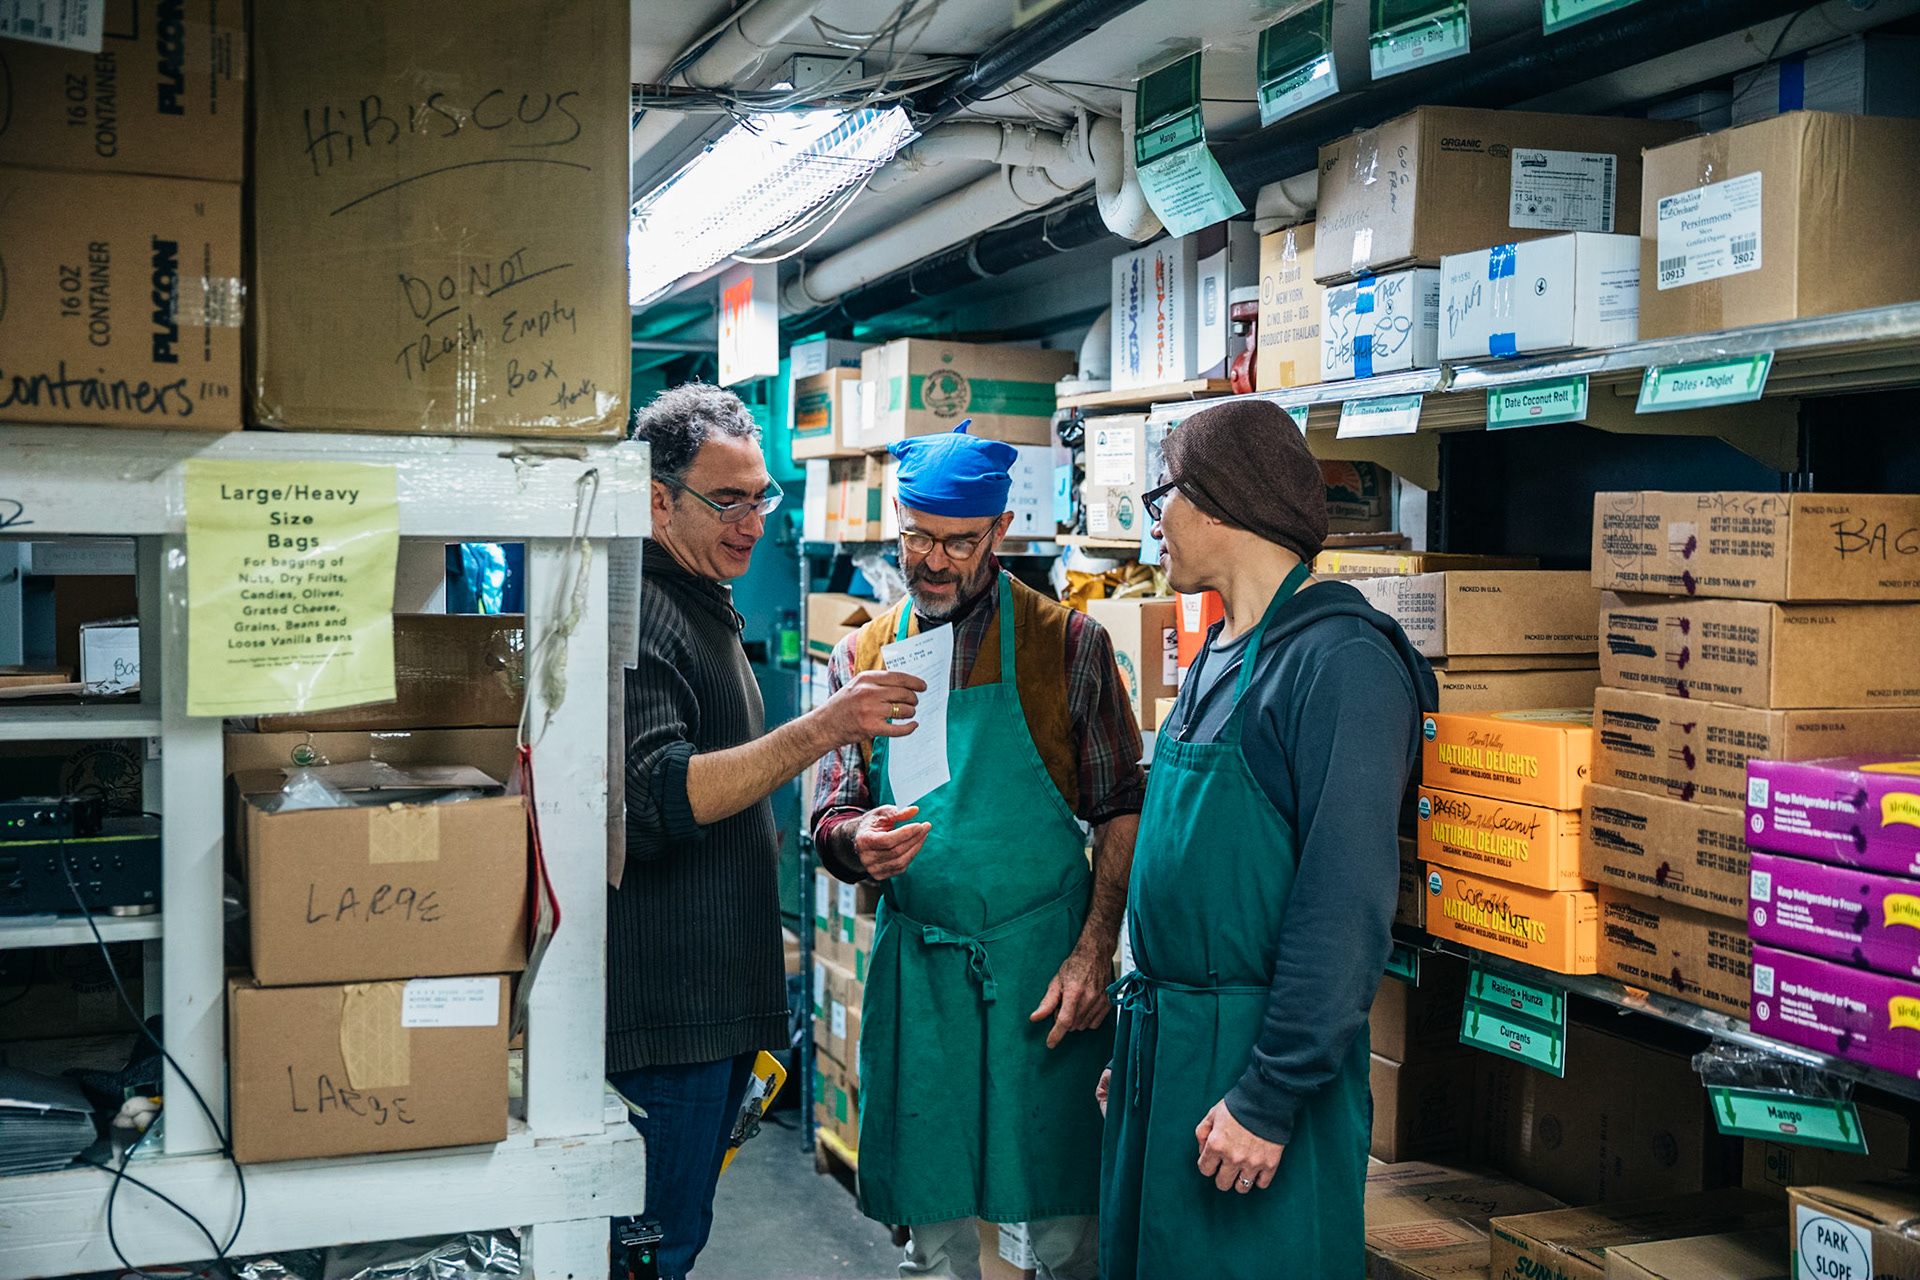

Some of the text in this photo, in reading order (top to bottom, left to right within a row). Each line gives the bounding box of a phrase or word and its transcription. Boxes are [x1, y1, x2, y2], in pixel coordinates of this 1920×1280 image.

[1391, 29, 1444, 54] Cherries Bing
[66, 74, 88, 126] 16 OZ
[1160, 131, 1177, 145] Mango
[1441, 138, 1482, 148] ORGANIC
[1681, 212, 1732, 232] Persimmons
[1733, 252, 1755, 265] 2802
[1661, 269, 1685, 282] 10913
[60, 265, 82, 318] 16 OZ
[88, 241, 111, 348] CONTAINER
[152, 239, 179, 364] PLACON
[1275, 287, 1304, 306] NEW YORK
[501, 299, 578, 344] Empty
[1260, 323, 1321, 348] PRODUCT OF THAILAND
[506, 360, 558, 398] Box
[1671, 373, 1734, 393] Dates Deglet
[1504, 389, 1569, 409] Date Coconut Roll
[220, 484, 360, 505] Large/Heavy
[269, 511, 314, 526] Size
[267, 533, 320, 552] Bags
[244, 556, 344, 570] For bagging of
[280, 573, 303, 586] Dry
[308, 573, 348, 584] Fruits,
[1615, 572, 1741, 587] FREEZE OR LESS THAN
[240, 588, 344, 601] Candies, Olives,
[242, 603, 341, 617] Grated Cheese,
[234, 616, 347, 634] Grains, Beans and
[1783, 617, 1809, 625] PACKED
[228, 632, 353, 649] Loose Vanilla Beans
[1620, 671, 1729, 694] FREEZE OR AT LESS THAN
[1866, 689, 1892, 697] PACKED
[1607, 719, 1657, 732] PITTED DEGLET NOOR
[1707, 726, 1719, 735] NET
[1438, 743, 1538, 778] NATURAL DELIGHTS
[1450, 766, 1522, 785] ORGANIC MEDJOOL DATE ROLLS
[1615, 769, 1737, 799] FREEZE OR LESS THAN
[1774, 791, 1791, 804] Keep
[1433, 795, 1471, 821] BAGGED
[1596, 815, 1646, 830] PITTED DEGLET NOOR
[1431, 821, 1529, 862] NATURAL DELIGHTS
[1442, 845, 1512, 867] ORGANIC MEDJOOL DATE ROLLS
[1603, 865, 1626, 878] FREEZE
[1627, 871, 1637, 879] OR
[1682, 884, 1690, 893] AT
[1691, 887, 1708, 899] LESS
[1709, 892, 1728, 903] THAN
[1776, 886, 1793, 900] Keep
[1793, 888, 1832, 905] Refrigerated
[1443, 897, 1488, 928] NATURAL
[1609, 910, 1659, 930] PITTED NOOR
[1455, 921, 1528, 949] ORGANIC MEDJOOL DATE ROLLS
[1491, 980, 1543, 1006] Raisins Hunza
[1617, 962, 1739, 1006] FREEZE OR LESS THAN
[1780, 980, 1797, 995] Keep
[1797, 984, 1836, 1005] Refrigerated
[1500, 1025, 1531, 1044] Currants
[1768, 1105, 1802, 1123] Mango
[1817, 1225, 1849, 1254] PARK
